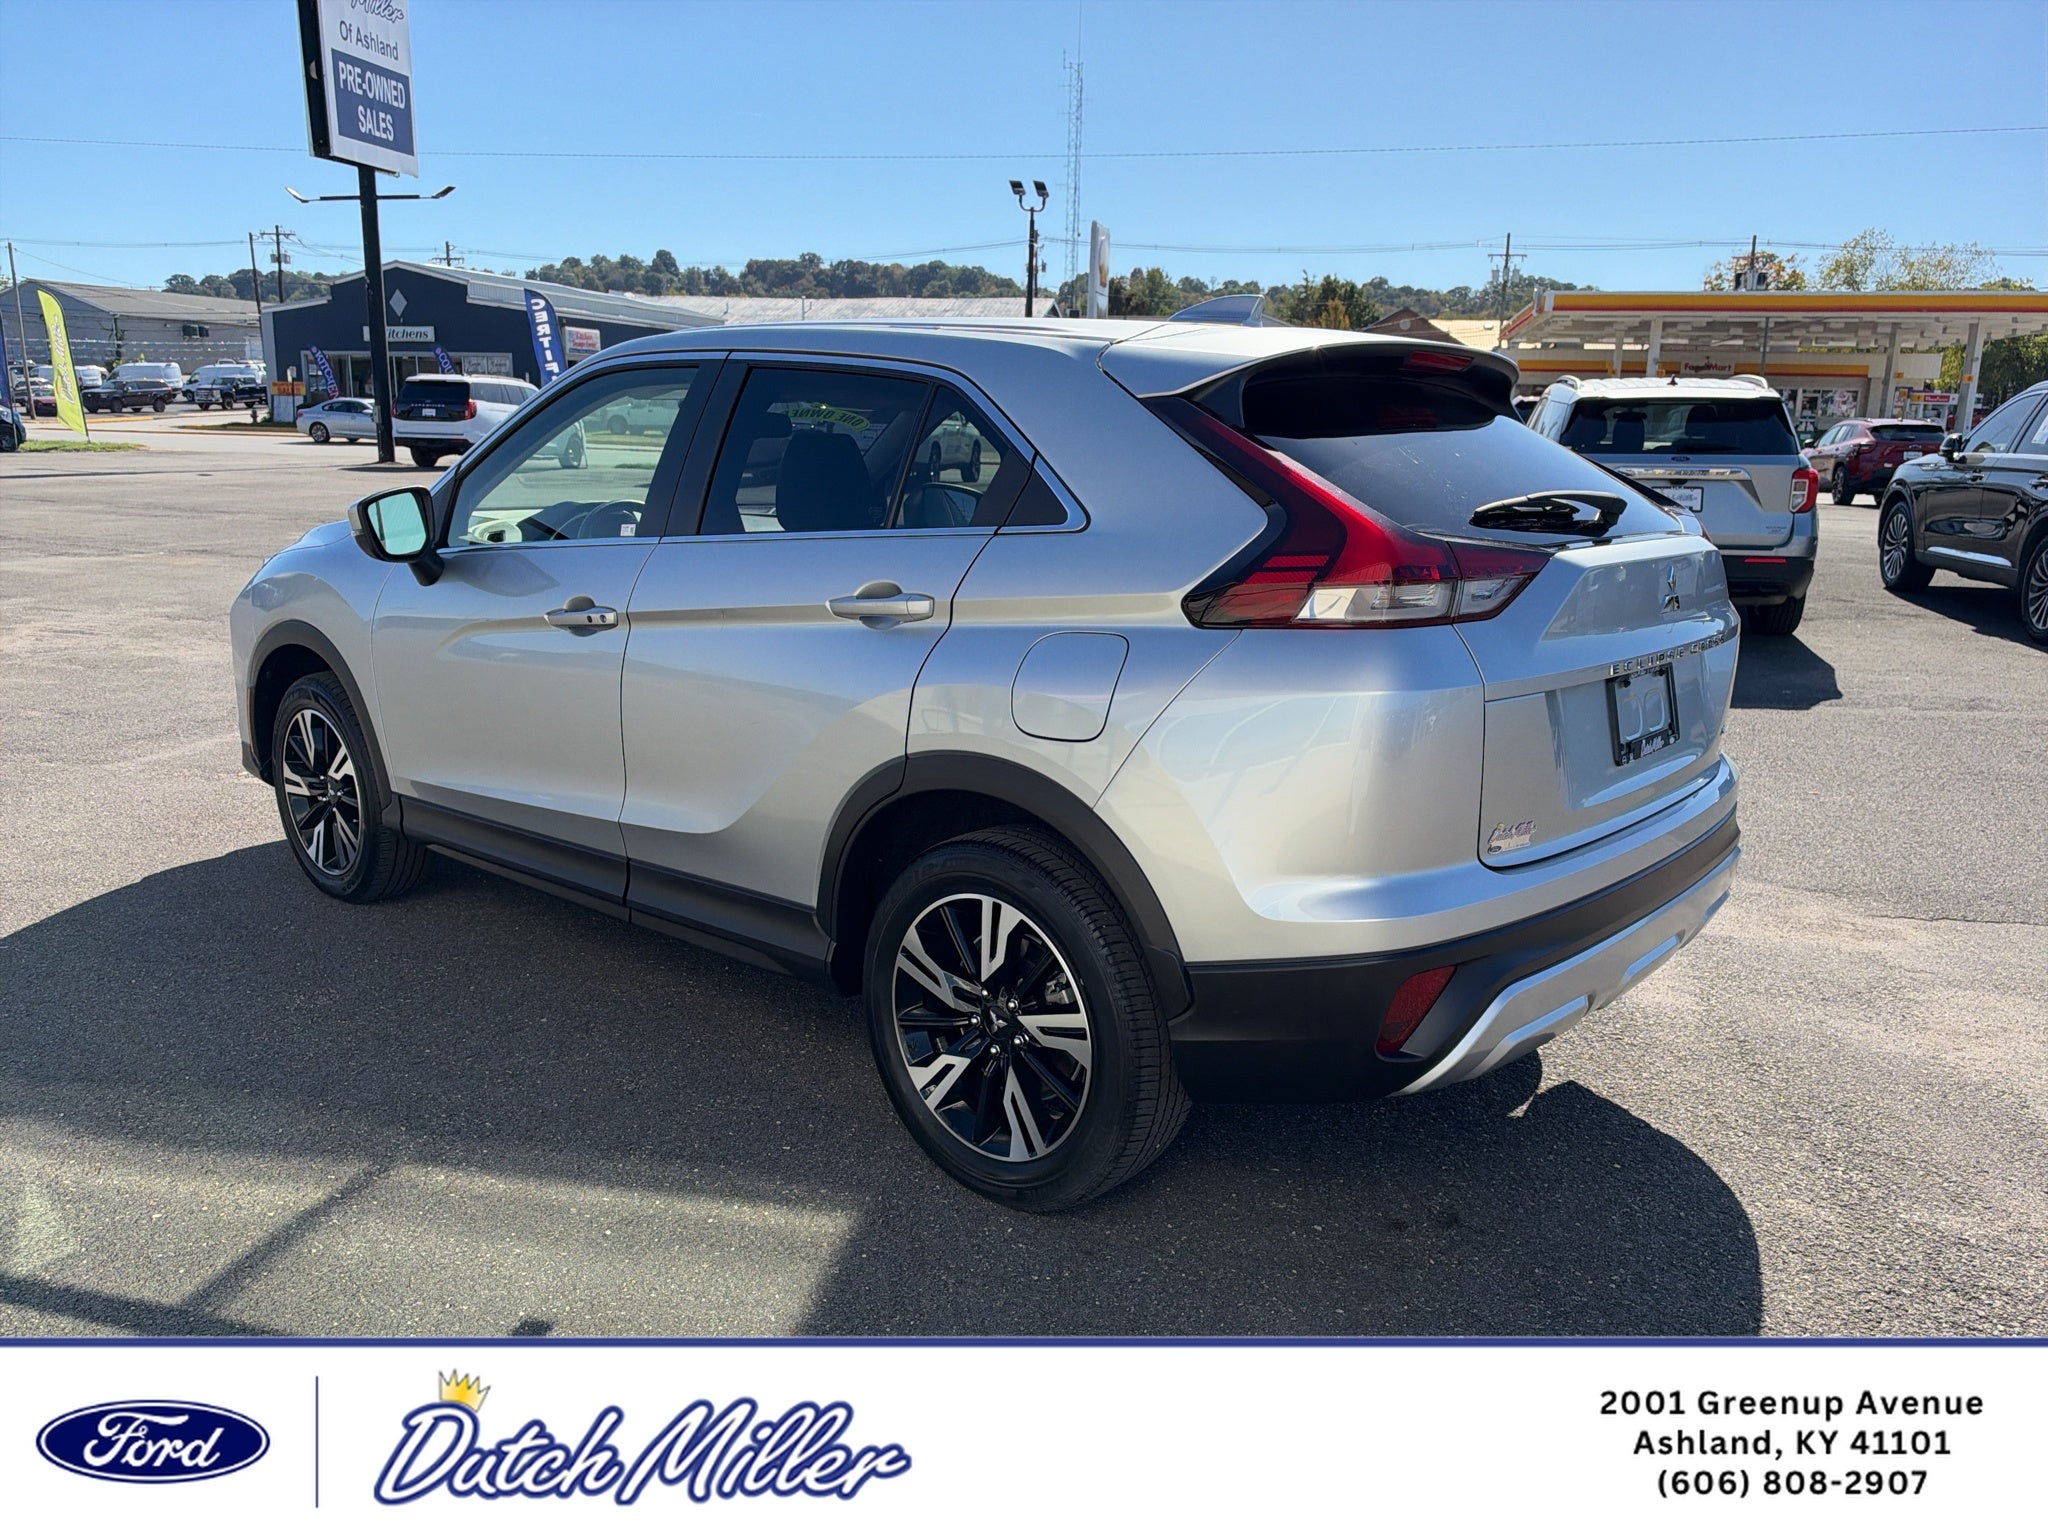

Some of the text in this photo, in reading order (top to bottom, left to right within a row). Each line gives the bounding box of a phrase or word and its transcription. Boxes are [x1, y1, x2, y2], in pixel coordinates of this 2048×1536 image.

[340, 20, 398, 61] Of Ashland
[339, 61, 405, 109] PRE-OWNED
[358, 105, 394, 141] SALES
[1609, 648, 1685, 676] ECLIPSE
[1690, 634, 1726, 655] CROSS
